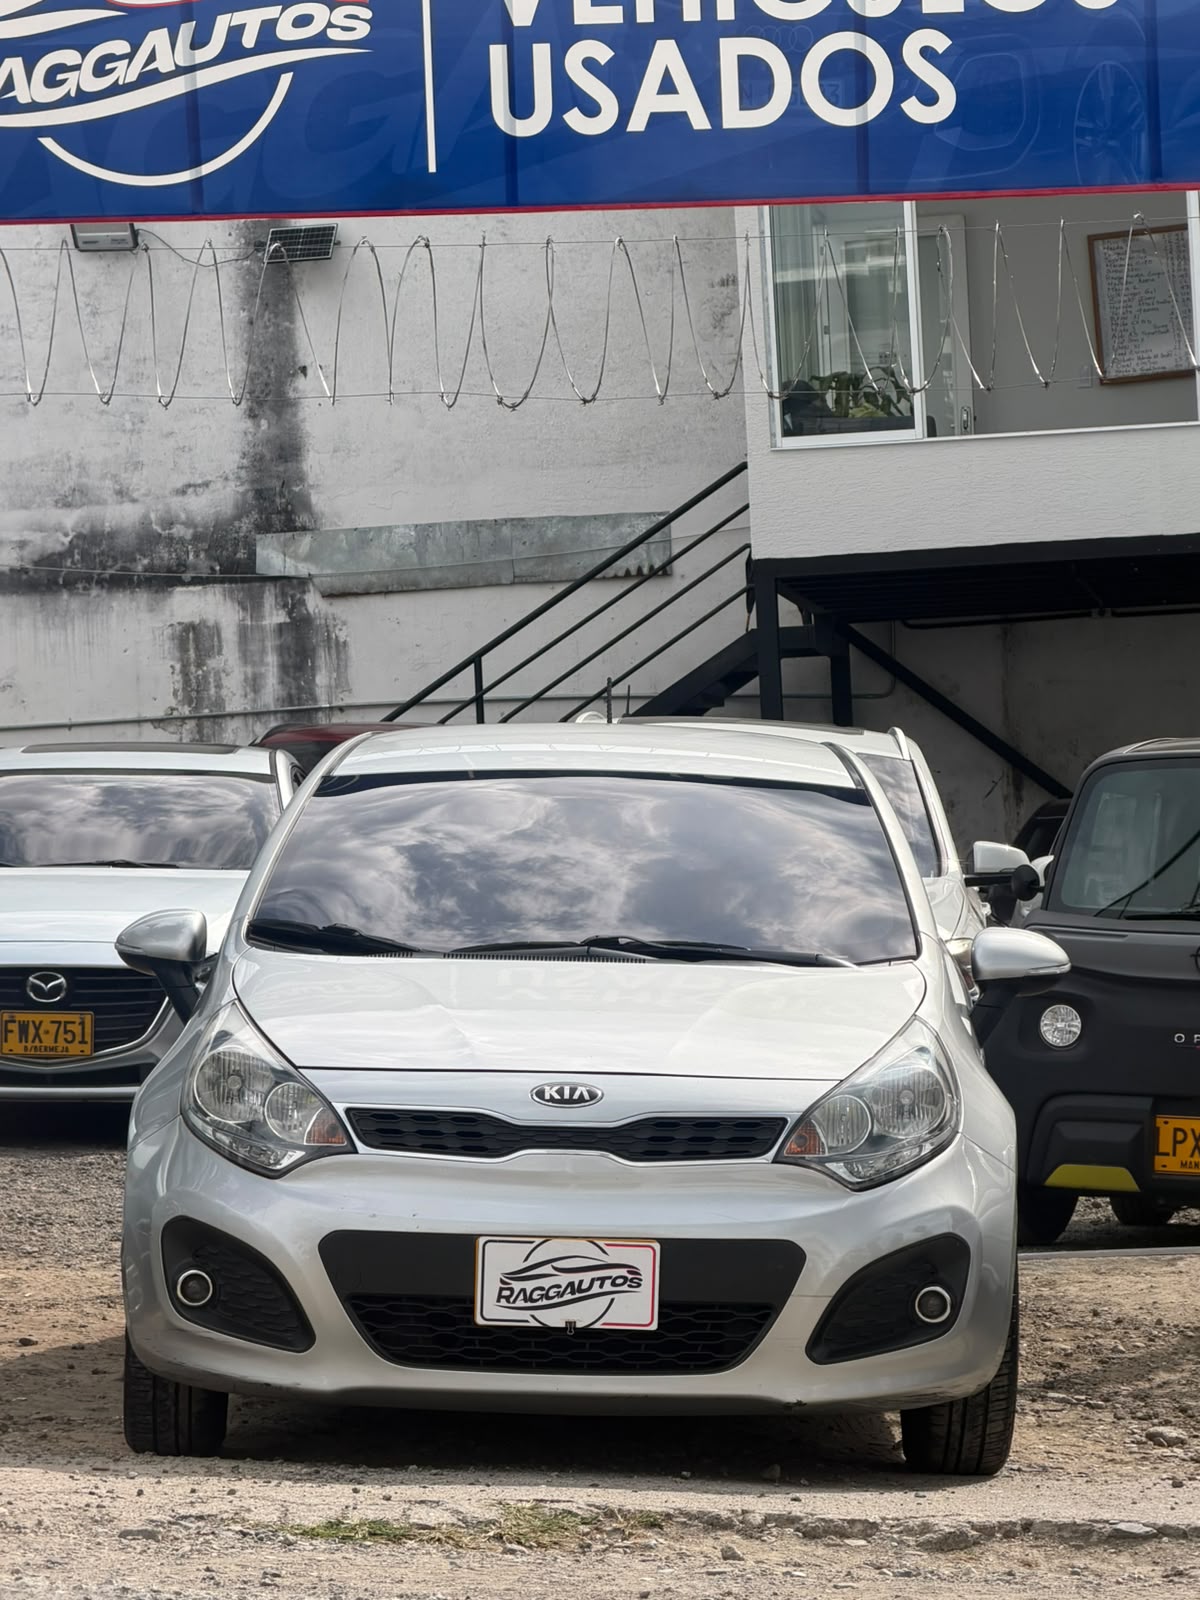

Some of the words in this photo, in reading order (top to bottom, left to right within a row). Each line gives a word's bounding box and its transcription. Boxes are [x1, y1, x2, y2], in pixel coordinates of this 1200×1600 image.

[489, 29, 957, 138] USADOS
[544, 1085, 590, 1101] KIA
[496, 1275, 643, 1304] RAGGAUTOS
